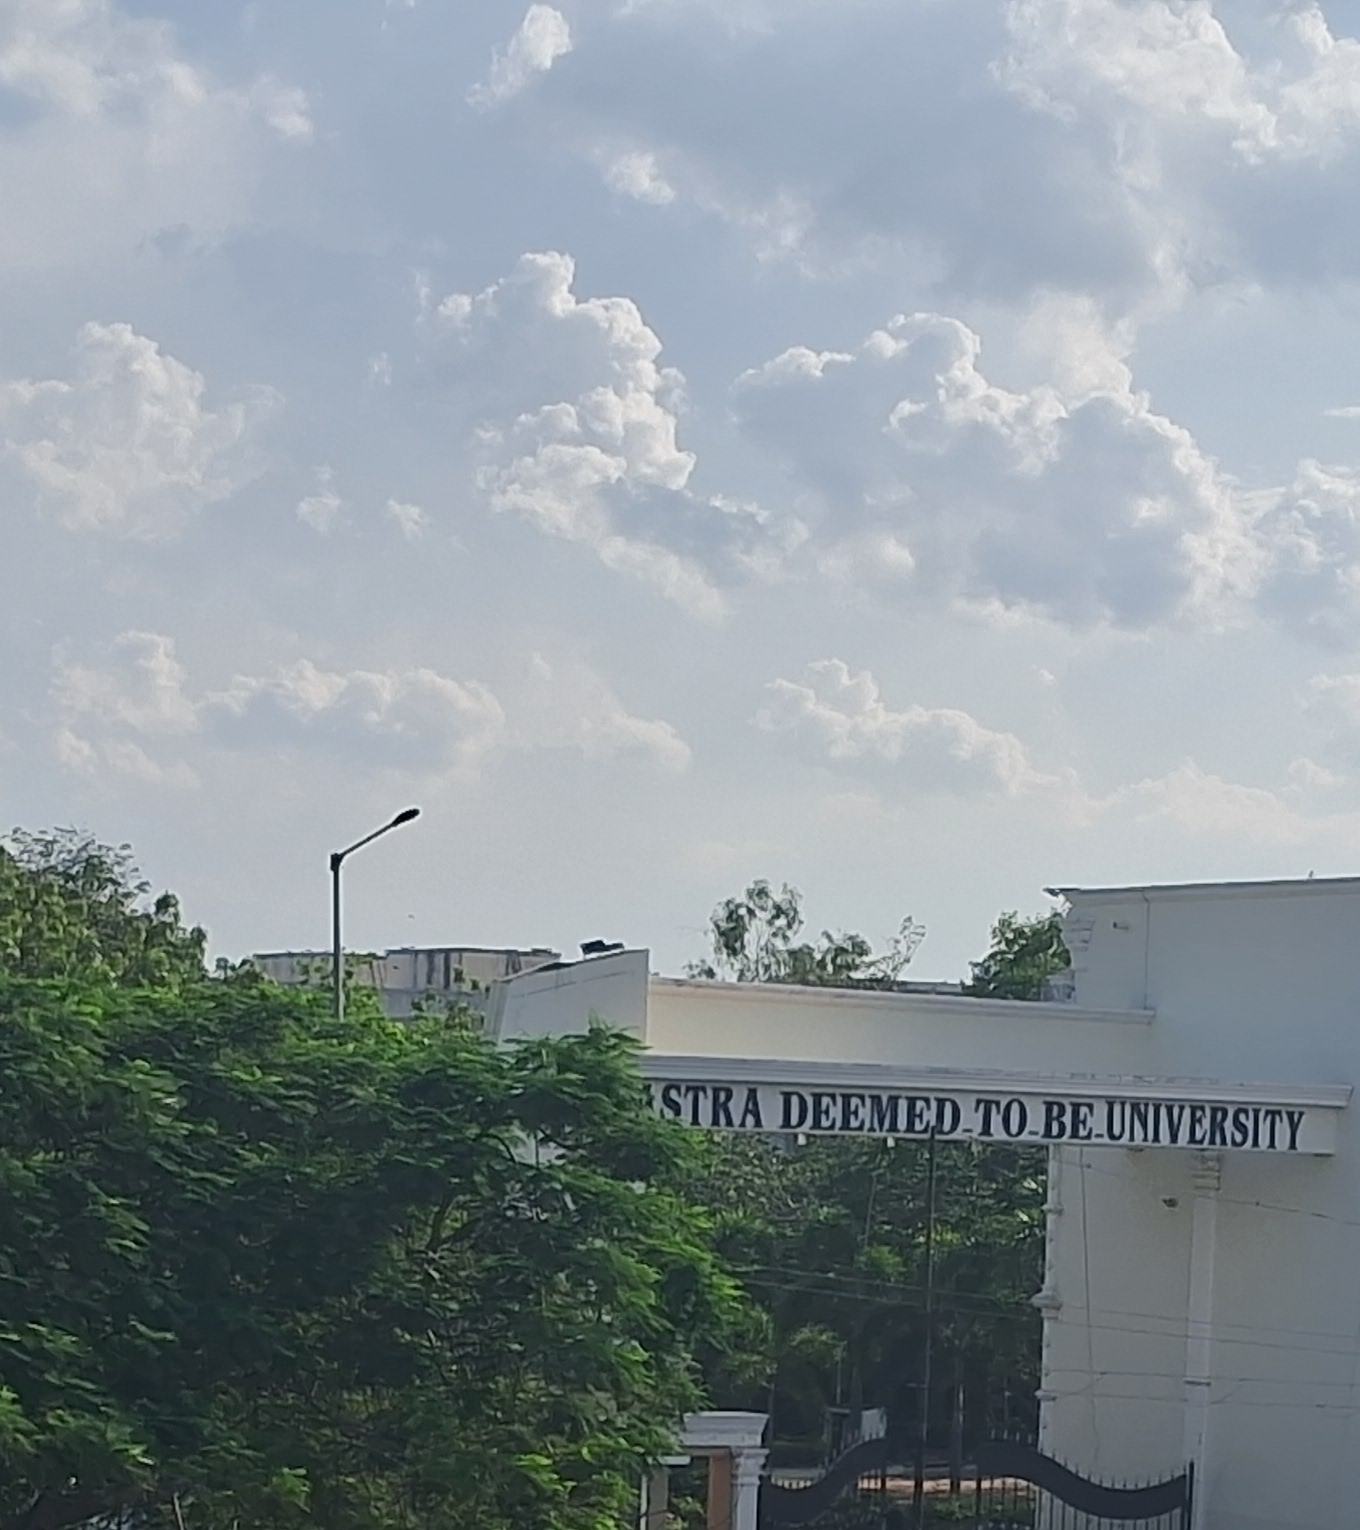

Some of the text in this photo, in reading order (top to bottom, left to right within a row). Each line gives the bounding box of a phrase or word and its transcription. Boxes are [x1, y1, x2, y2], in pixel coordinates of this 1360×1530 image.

[779, 1090, 962, 1136] DEEMED
[974, 1097, 1029, 1138] TO
[1041, 1100, 1094, 1141] BE
[1105, 1101, 1305, 1151] UNIVERSITY
